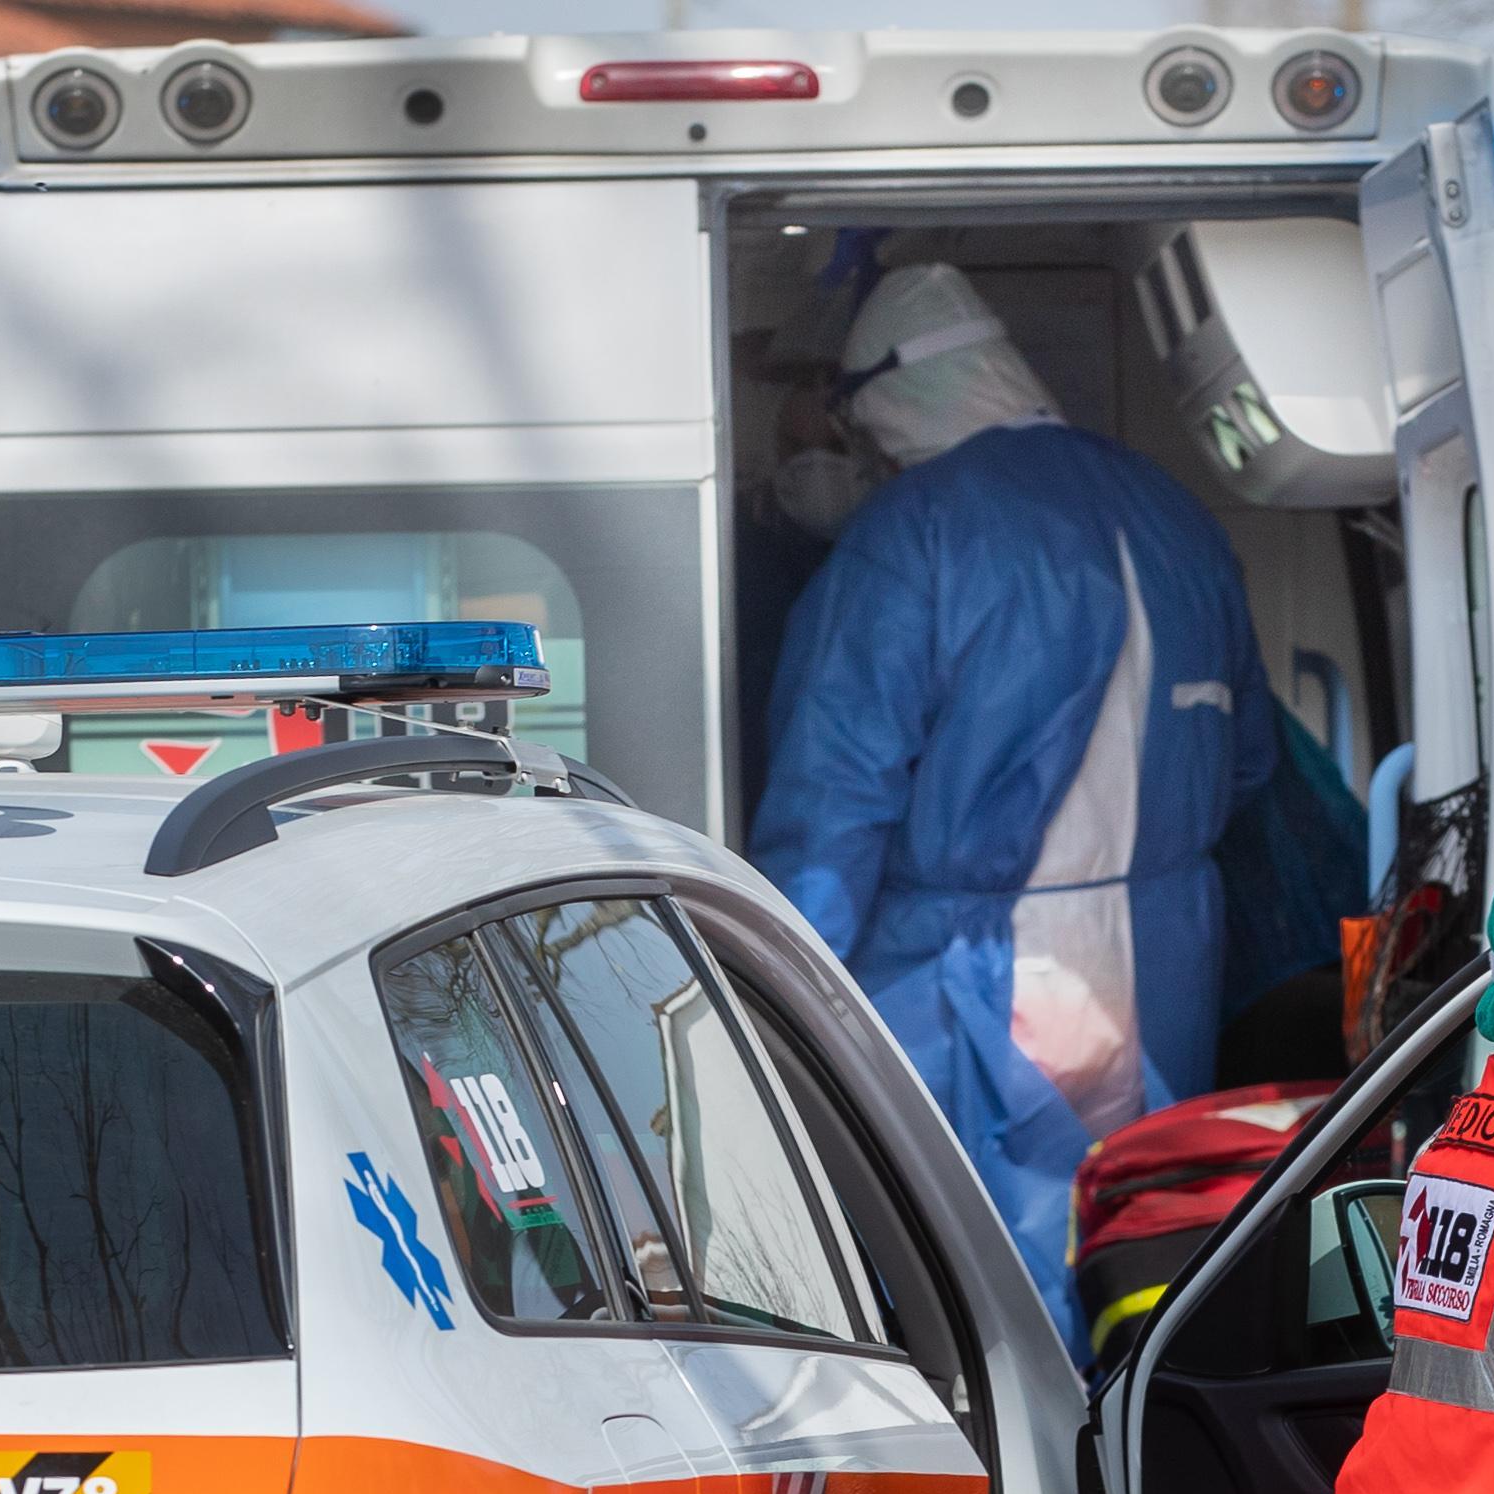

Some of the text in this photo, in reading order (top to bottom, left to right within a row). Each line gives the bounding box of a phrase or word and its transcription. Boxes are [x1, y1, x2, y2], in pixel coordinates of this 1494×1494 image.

[450, 1073, 545, 1192] 118
[1418, 1206, 1477, 1283] 118
[1465, 1256, 1481, 1287] EMILIA
